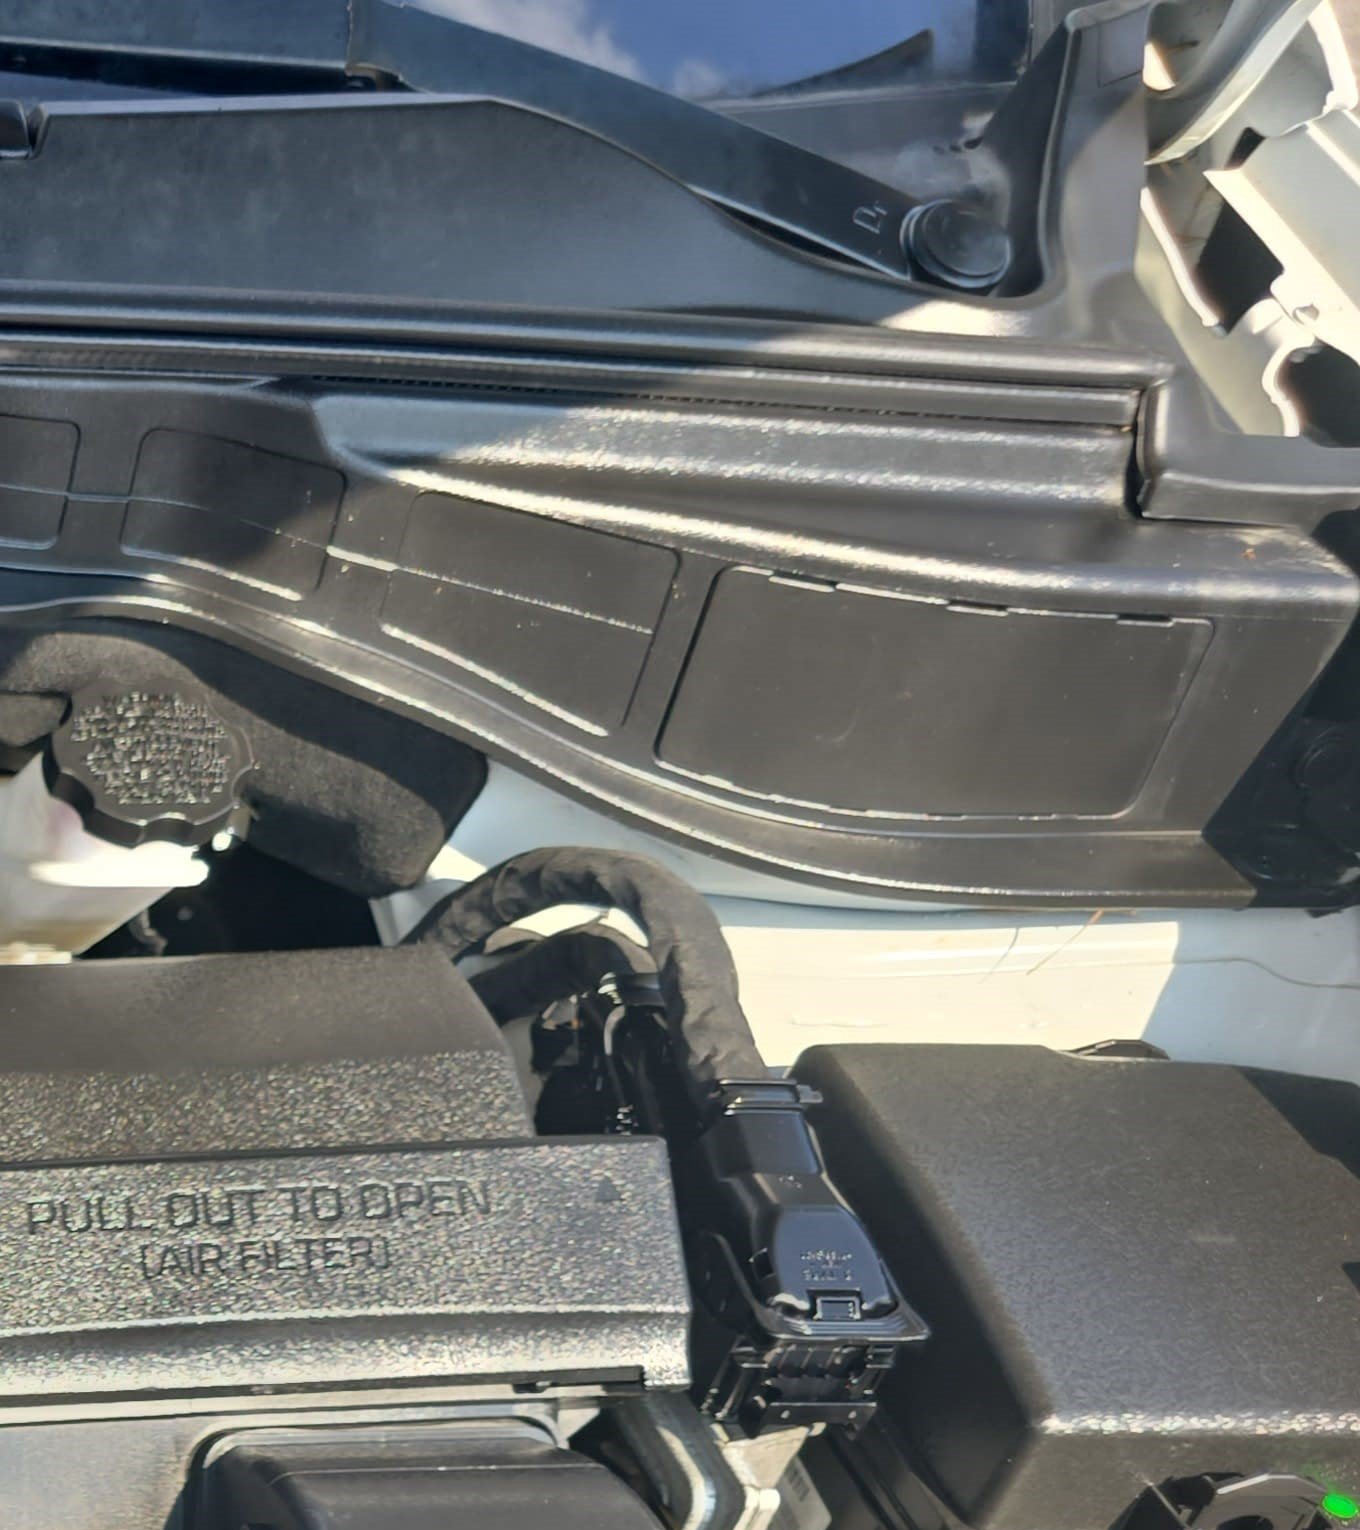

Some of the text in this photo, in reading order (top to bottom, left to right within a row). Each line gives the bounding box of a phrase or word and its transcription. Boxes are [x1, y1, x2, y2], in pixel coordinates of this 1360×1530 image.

[28, 1176, 489, 1235] PULL OUT TO OPEN
